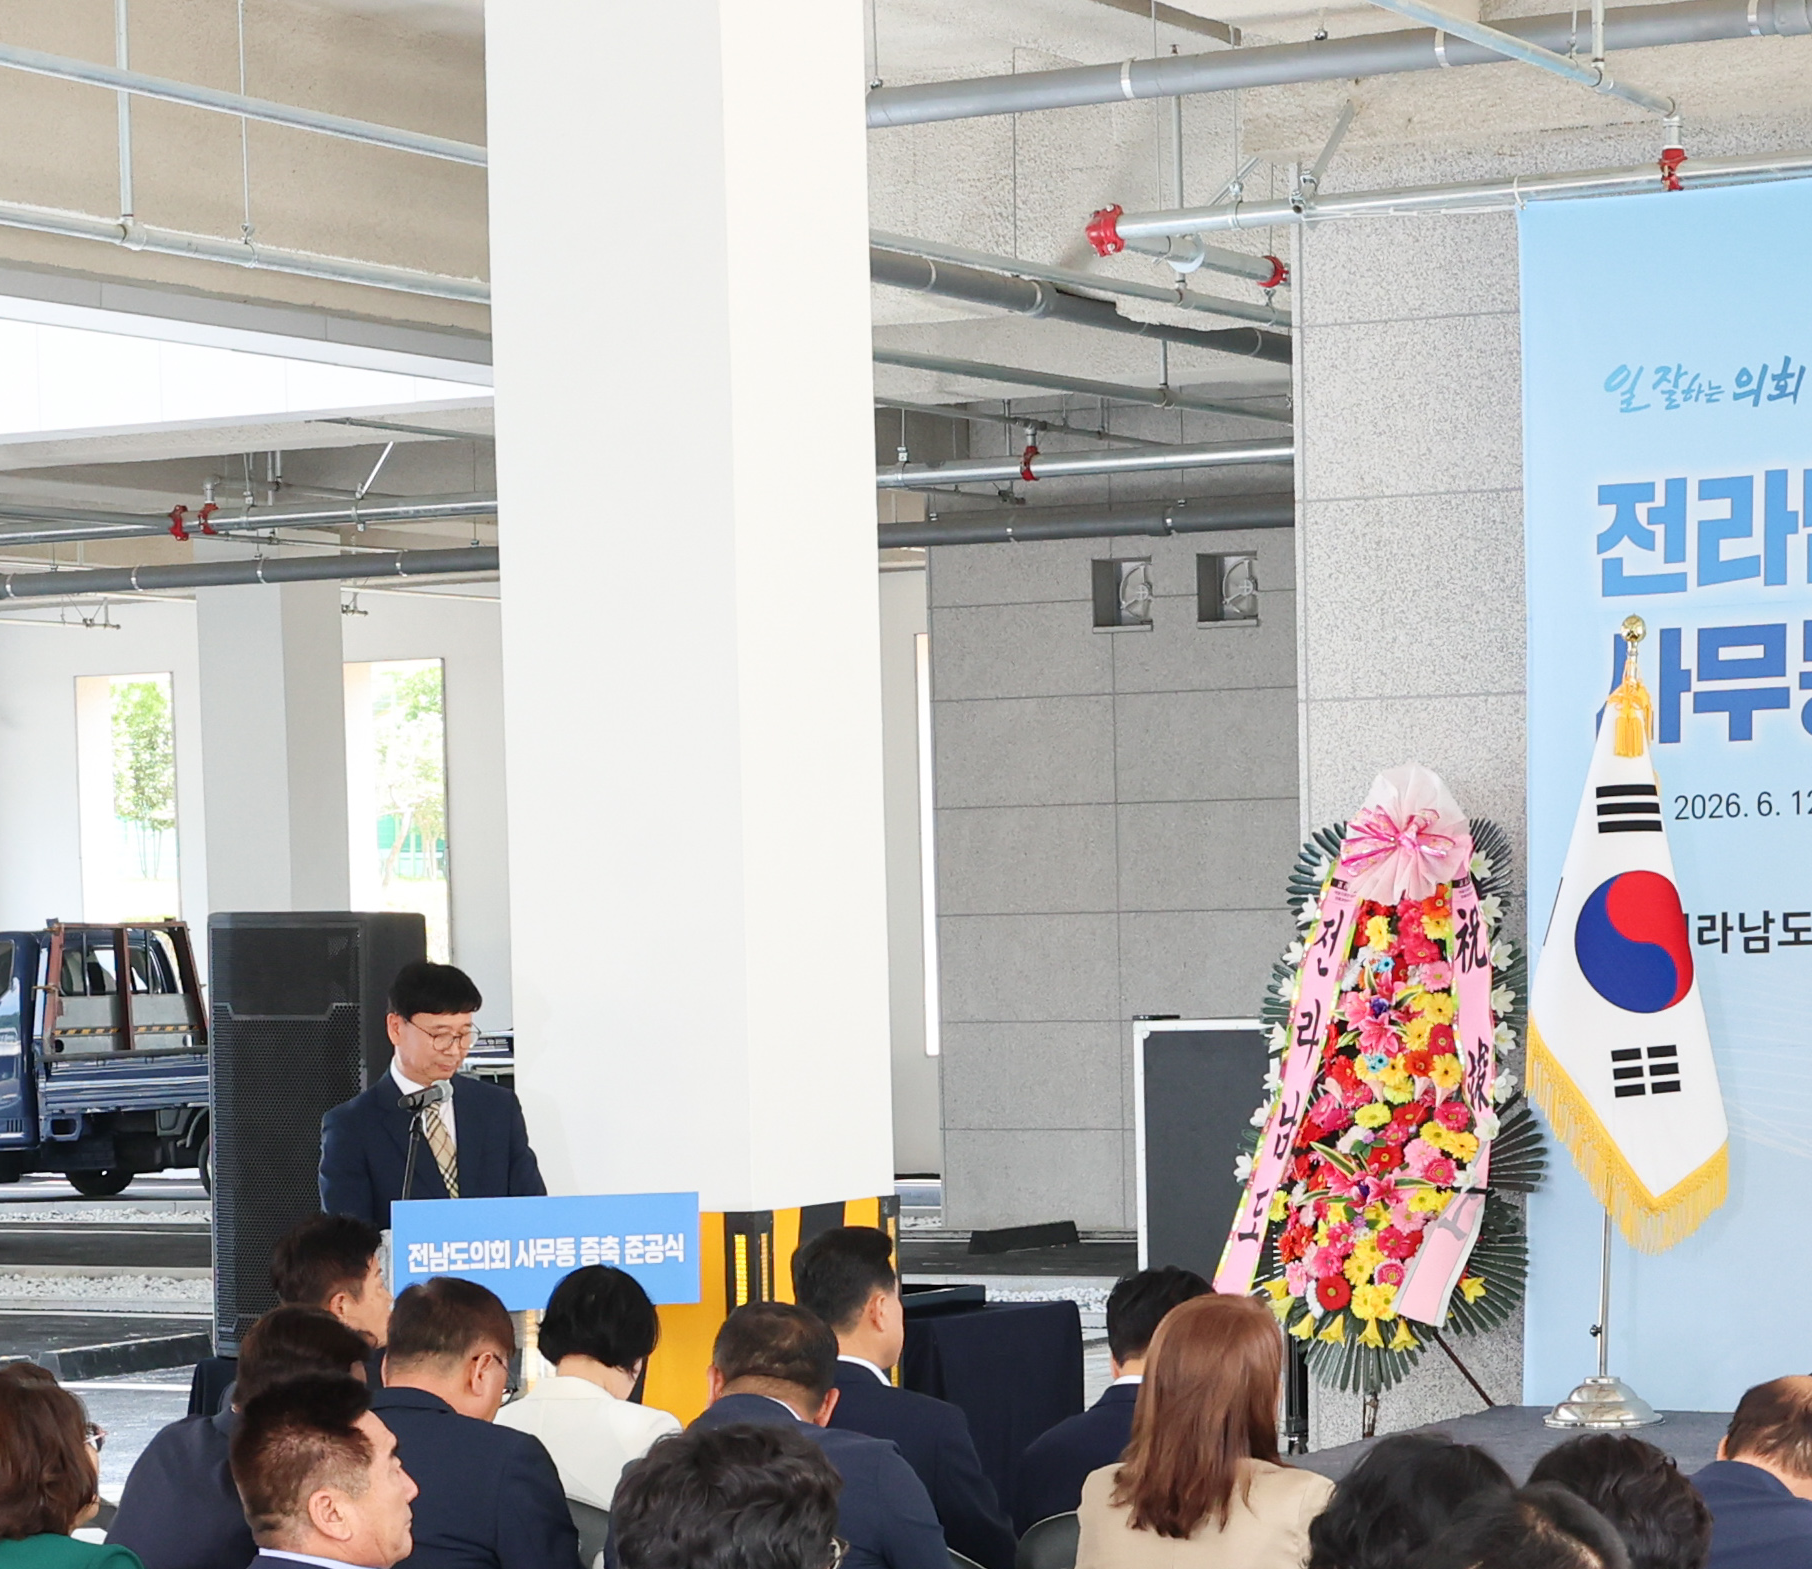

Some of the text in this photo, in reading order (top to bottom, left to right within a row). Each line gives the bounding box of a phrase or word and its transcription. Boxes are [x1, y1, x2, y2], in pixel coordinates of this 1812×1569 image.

[1604, 363, 1651, 413] 일
[1652, 363, 1724, 411] 잘하는
[1733, 356, 1806, 408] 의회
[1674, 793, 1749, 820] 2026.
[1757, 791, 1780, 816] 6.
[408, 1233, 685, 1274] 전남도의회 사무동 증축 준공식
